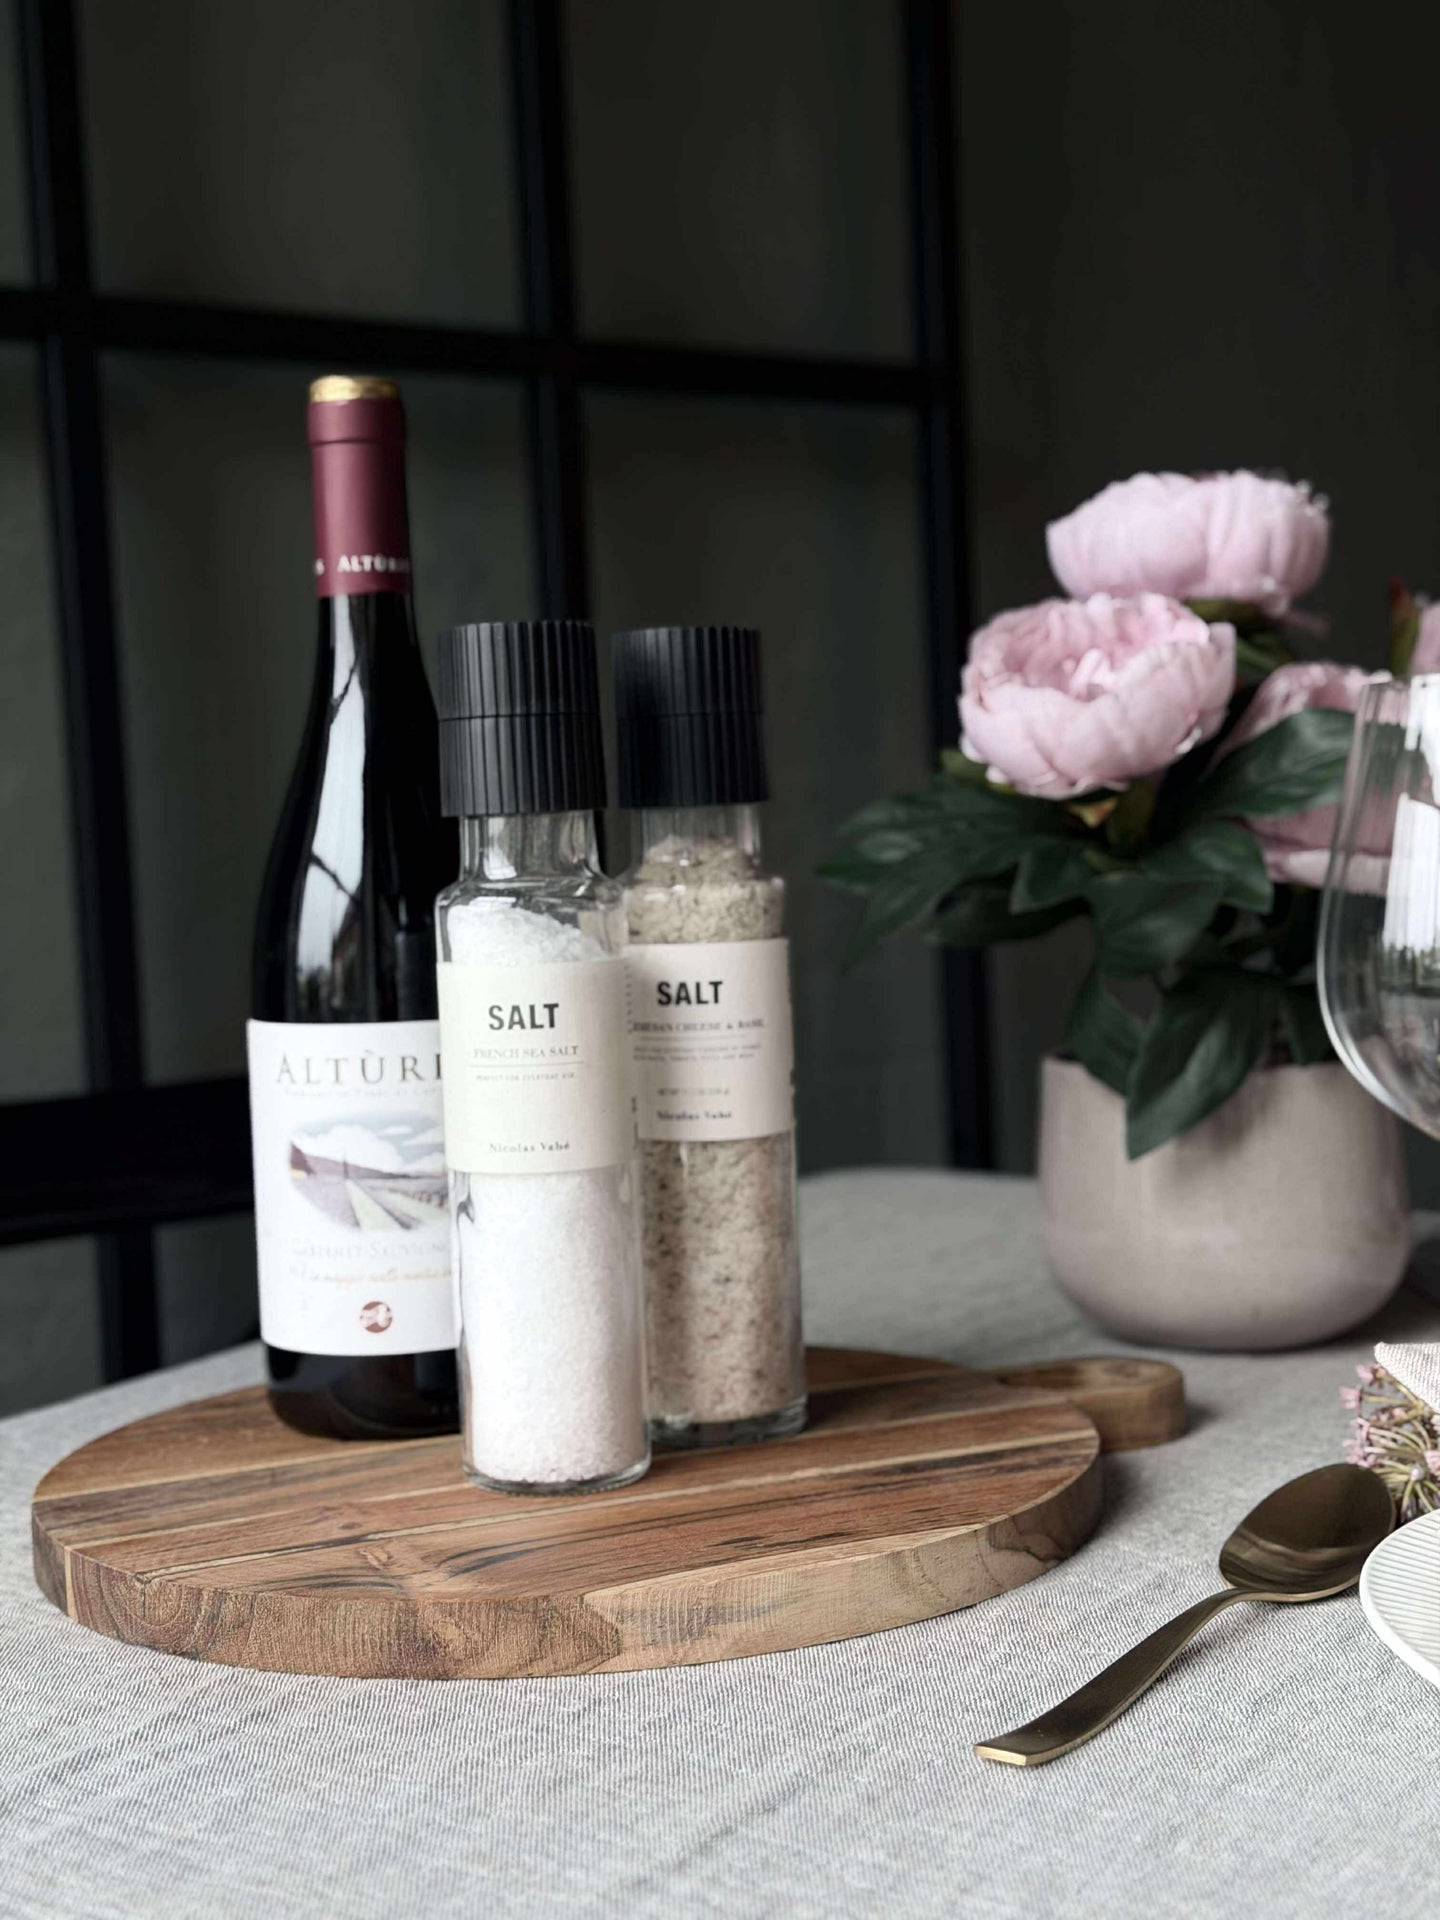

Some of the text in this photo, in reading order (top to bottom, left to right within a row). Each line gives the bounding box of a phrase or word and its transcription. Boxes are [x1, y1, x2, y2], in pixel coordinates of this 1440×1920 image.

[657, 981, 723, 1006] SALT
[488, 1003, 559, 1030] SALT
[473, 1045, 579, 1059] FRENCH SEA SALT
[488, 1143, 535, 1153] Nicolas
